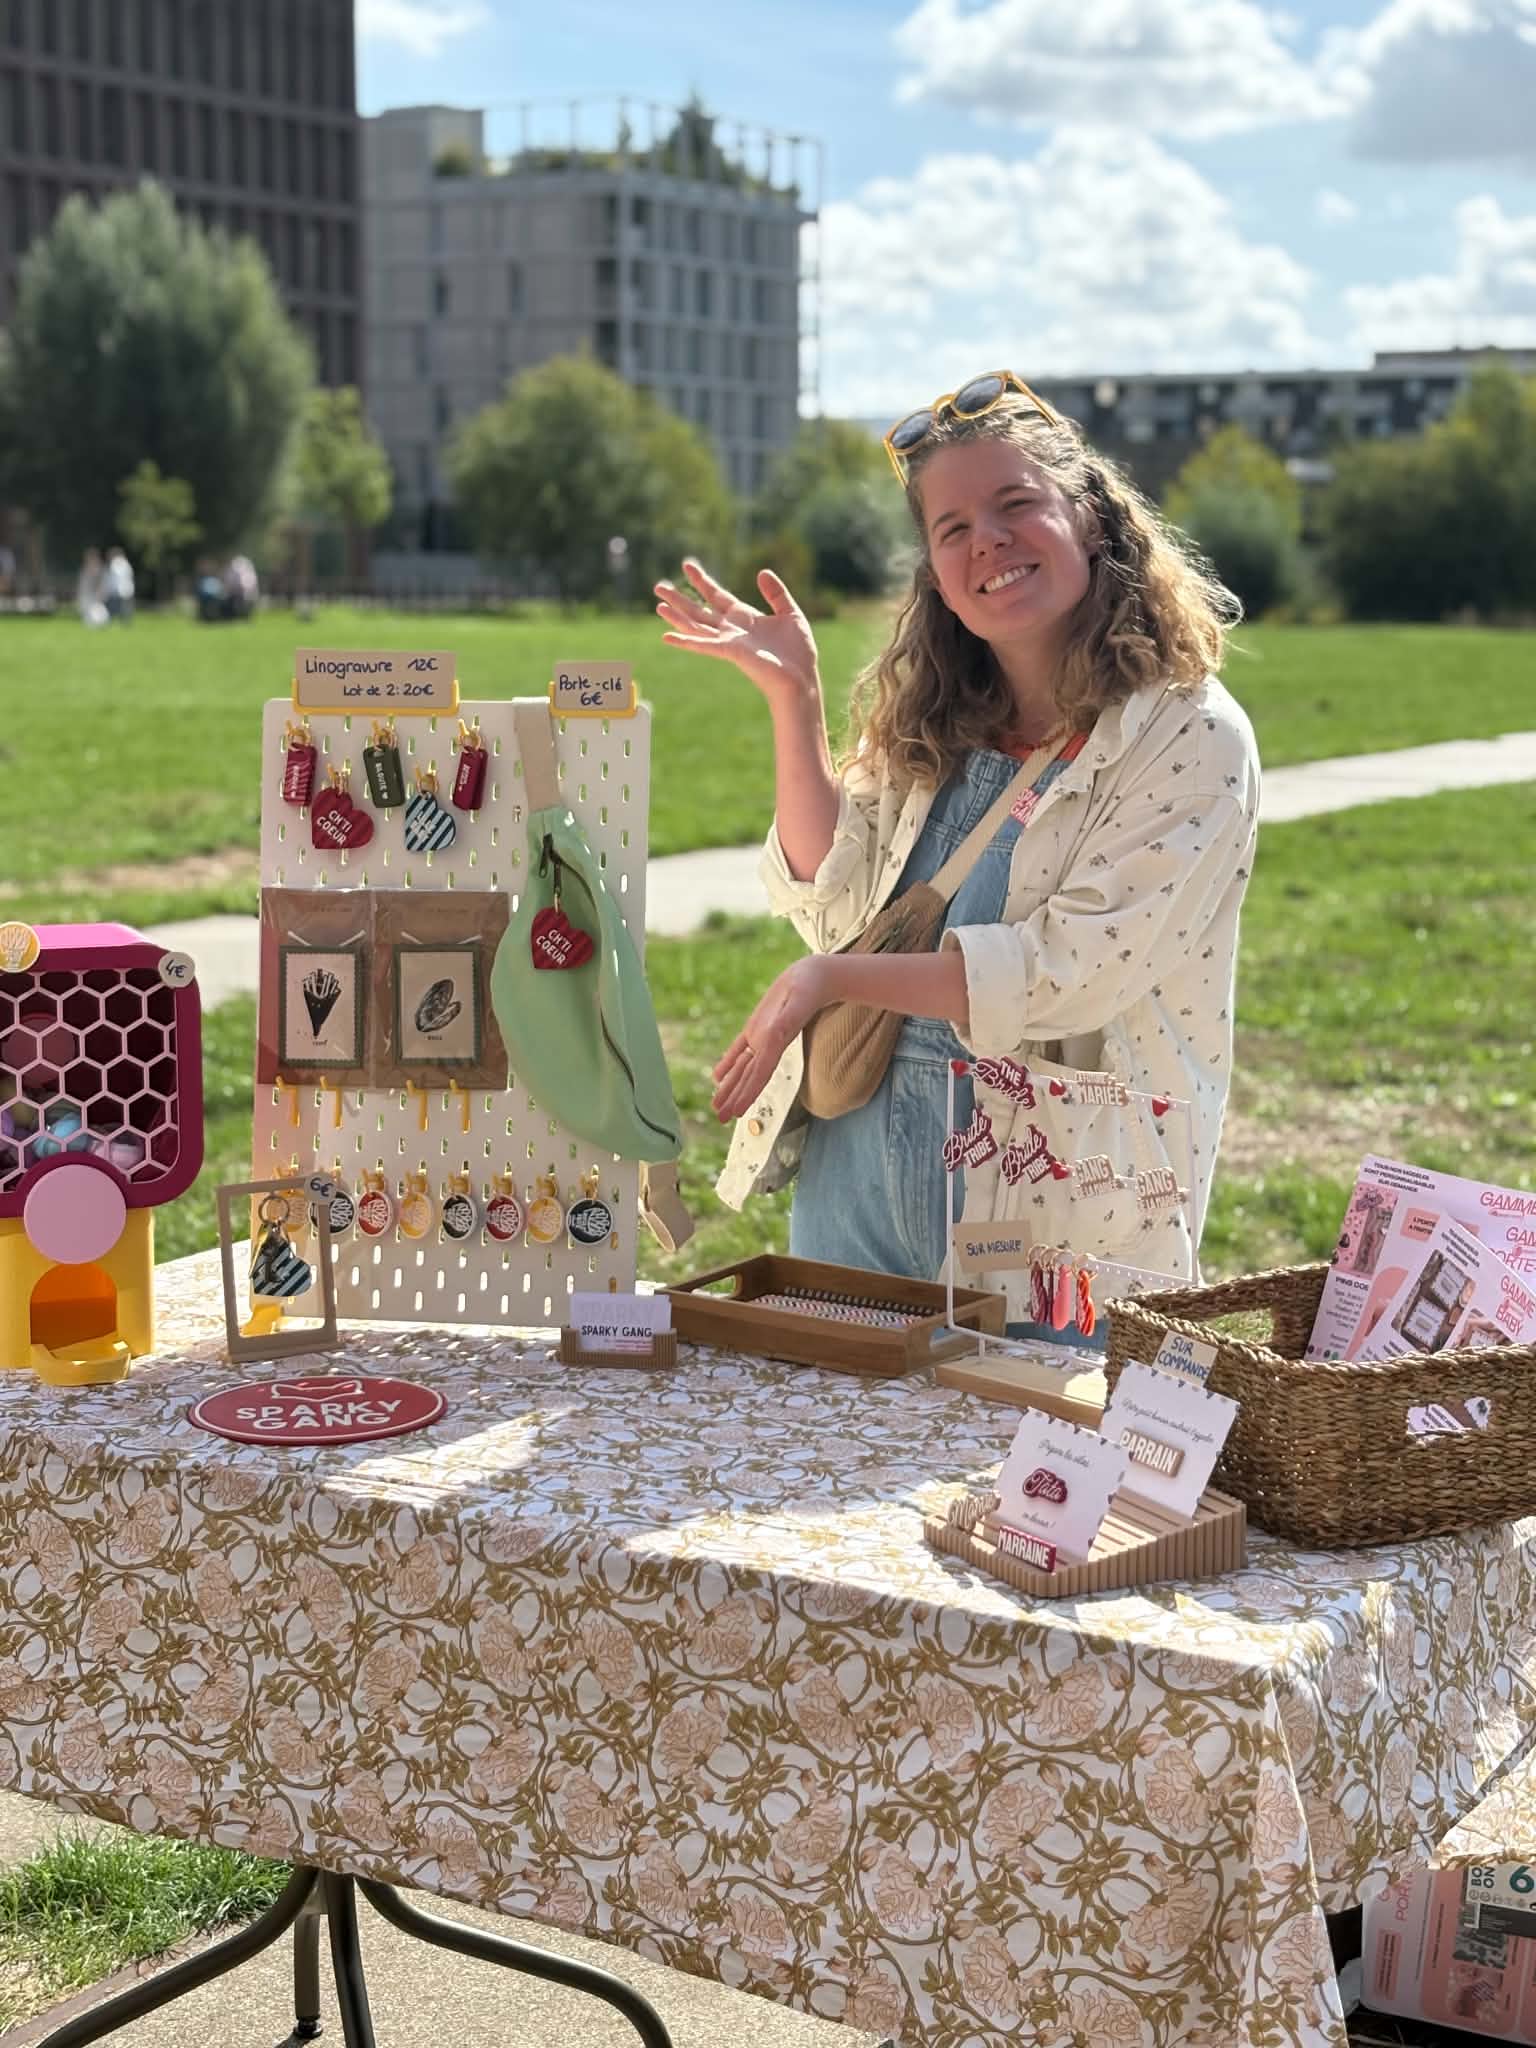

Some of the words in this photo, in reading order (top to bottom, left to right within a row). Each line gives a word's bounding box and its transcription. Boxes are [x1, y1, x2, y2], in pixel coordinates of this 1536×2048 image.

[305, 655, 393, 679] Linogravure
[407, 657, 439, 672] 12€
[343, 684, 362, 697] Lot
[367, 684, 381, 697] de
[404, 683, 435, 697] 20€
[580, 691, 603, 706] 6€
[316, 816, 347, 845] COEUR
[328, 810, 353, 833] CH'TI
[536, 935, 567, 965] COEUR
[548, 929, 573, 953] CH'TI
[165, 959, 188, 979] 4€
[974, 1061, 1031, 1105] Bride
[1001, 1060, 1022, 1087] THE
[942, 1108, 988, 1171] Bride
[963, 1136, 993, 1167] TRIBE
[1000, 1125, 1043, 1184] Bride
[1022, 1153, 1051, 1181] TRIBE
[310, 1176, 334, 1198] 6€
[1136, 1169, 1174, 1197] GANG
[1489, 1246, 1536, 1273] ORTE-
[1500, 1275, 1536, 1319] GAMME
[581, 1325, 618, 1337] SPARKY
[622, 1327, 652, 1338] GANG
[1495, 1303, 1524, 1337] BABY
[1170, 1336, 1194, 1357] SUR
[236, 1400, 403, 1420] SPARKY
[252, 1412, 391, 1431] GANG
[1120, 1430, 1180, 1474] PARRAIN
[998, 1530, 1050, 1570] MARRAINE
[1509, 1864, 1535, 1894] 6
